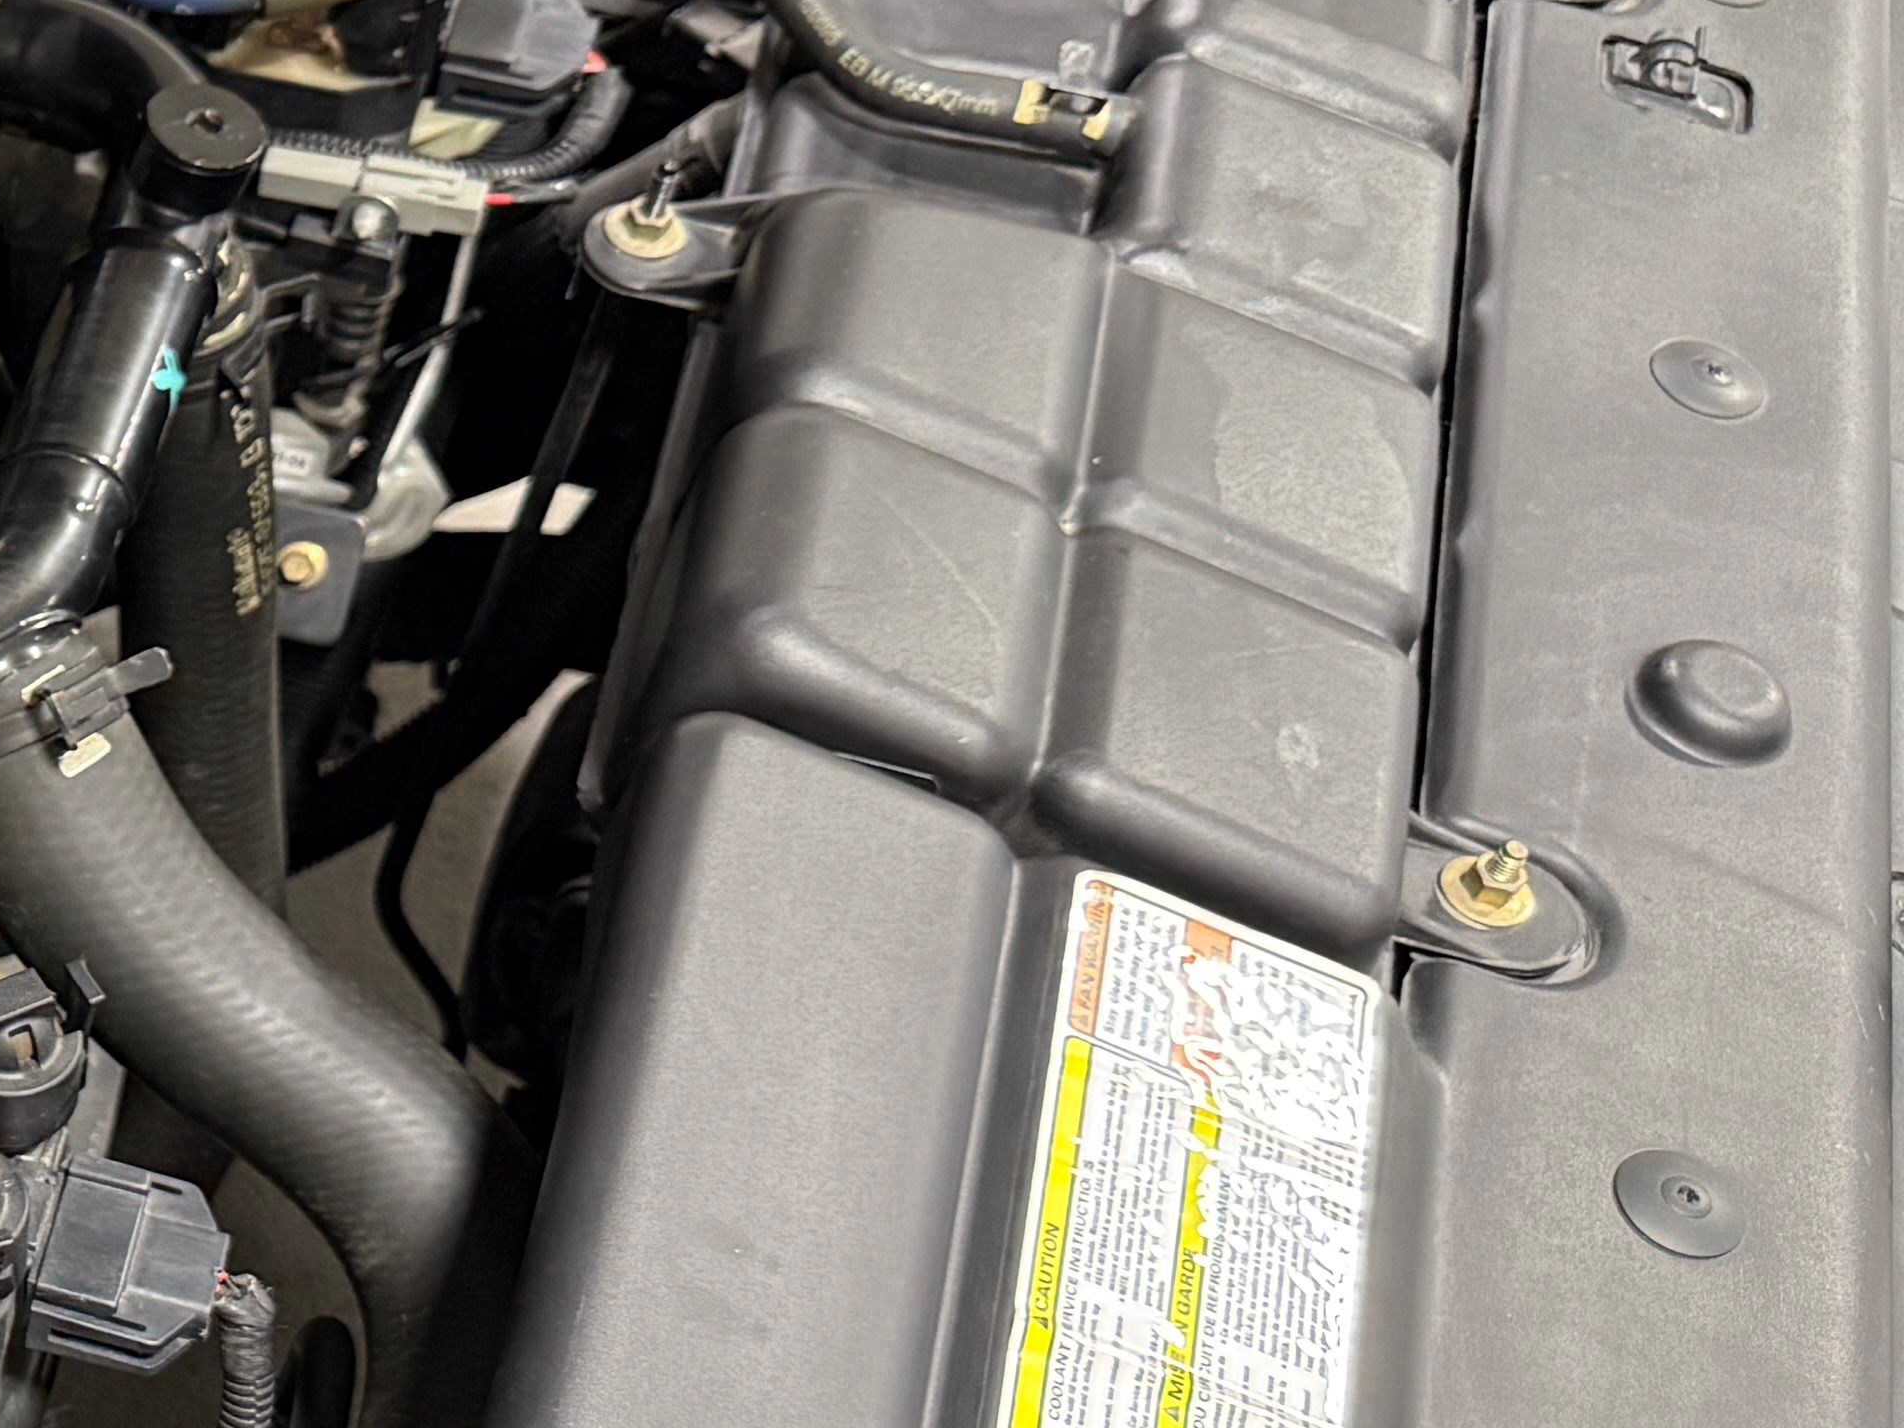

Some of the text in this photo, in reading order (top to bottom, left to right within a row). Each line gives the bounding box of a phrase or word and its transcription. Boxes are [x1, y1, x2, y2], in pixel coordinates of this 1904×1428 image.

[1080, 880, 1107, 969] WARNIN
[1033, 1220, 1060, 1313] CAUTION
[1047, 1158, 1094, 1421] COOLANT ERVICE INSTRUCTIOS
[1202, 1315, 1216, 1337] DE
